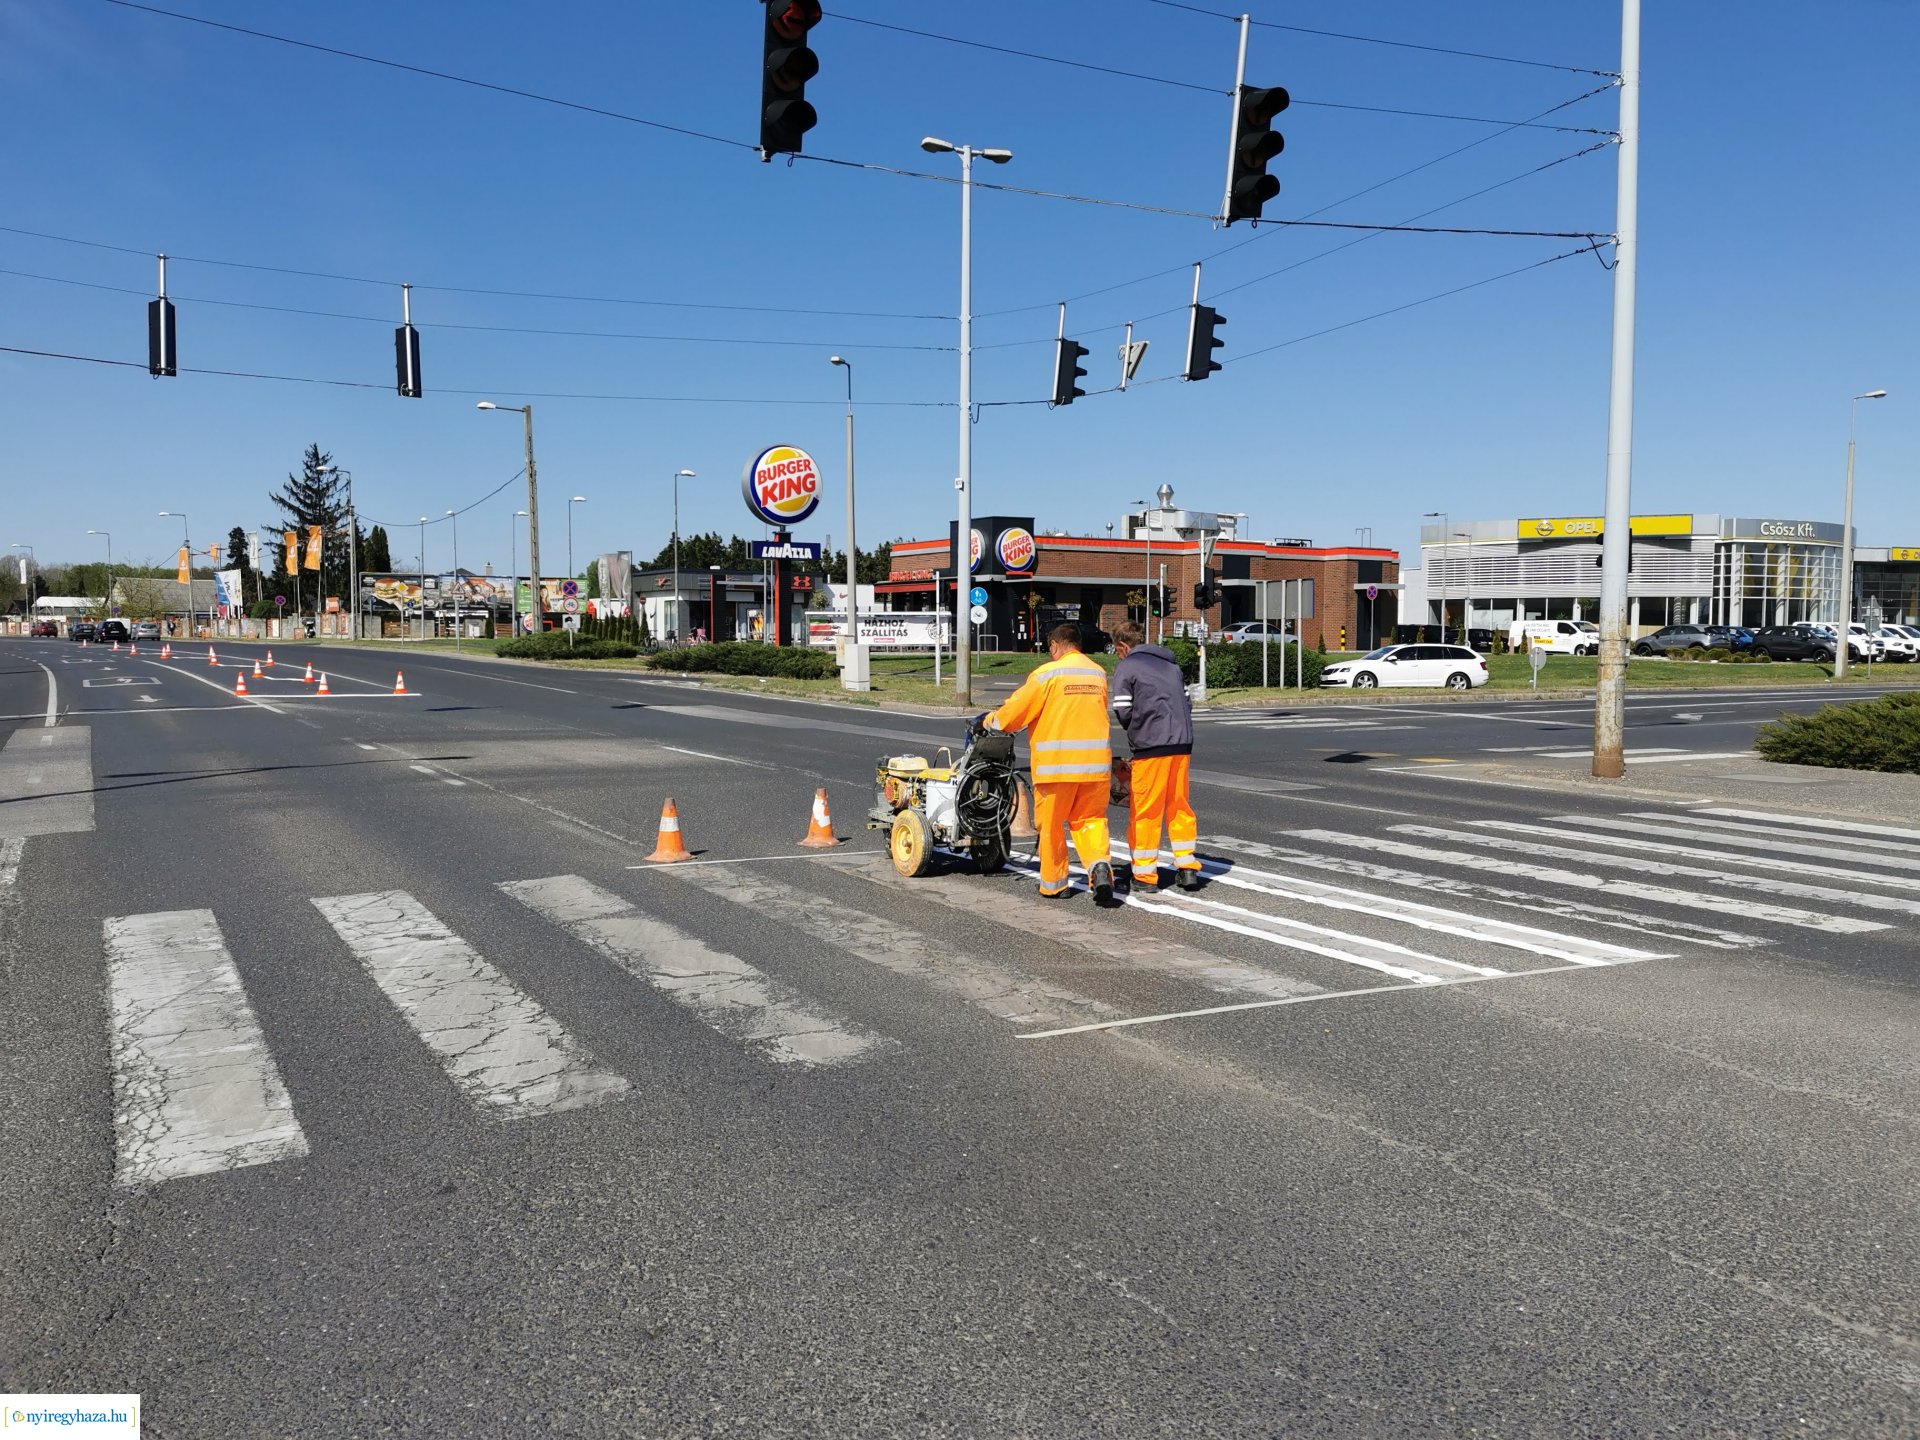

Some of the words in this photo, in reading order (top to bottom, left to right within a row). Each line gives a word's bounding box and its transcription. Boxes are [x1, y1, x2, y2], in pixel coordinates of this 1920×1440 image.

[757, 458, 812, 485] BURGER
[763, 473, 815, 506] KING
[1564, 521, 1599, 535] OPEL
[1760, 521, 1795, 537] Csősz
[1798, 522, 1816, 537] Kft.
[762, 543, 813, 559] LAVAZZA
[1002, 535, 1030, 553] BURGER
[1005, 543, 1032, 563] KING
[864, 617, 905, 627] HÁZHOZ
[860, 627, 908, 637] SZÁLLÍTÁS
